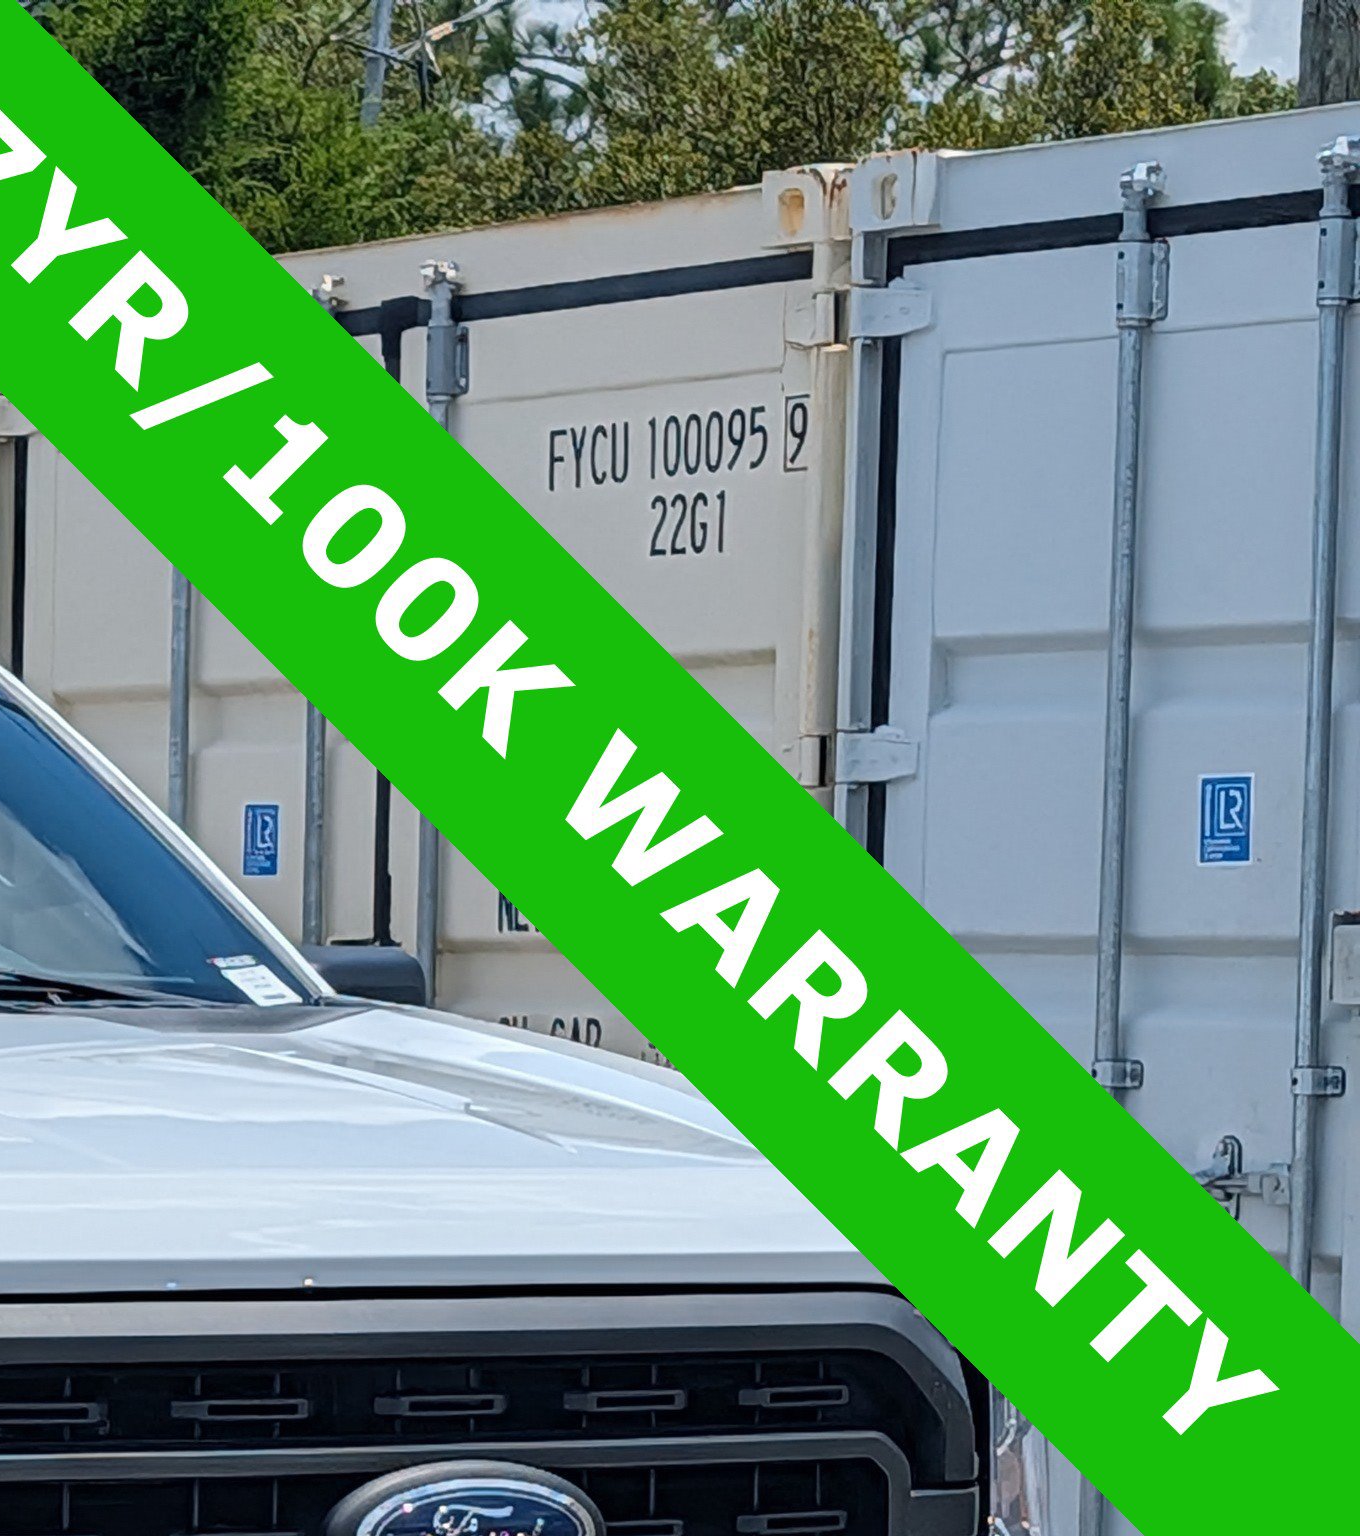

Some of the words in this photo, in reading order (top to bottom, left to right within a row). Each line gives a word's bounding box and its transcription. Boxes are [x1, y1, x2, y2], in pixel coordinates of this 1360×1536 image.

[548, 421, 629, 491] FYCU
[649, 405, 768, 479] 100095
[789, 402, 809, 464] 9
[650, 490, 726, 556] 22G1
